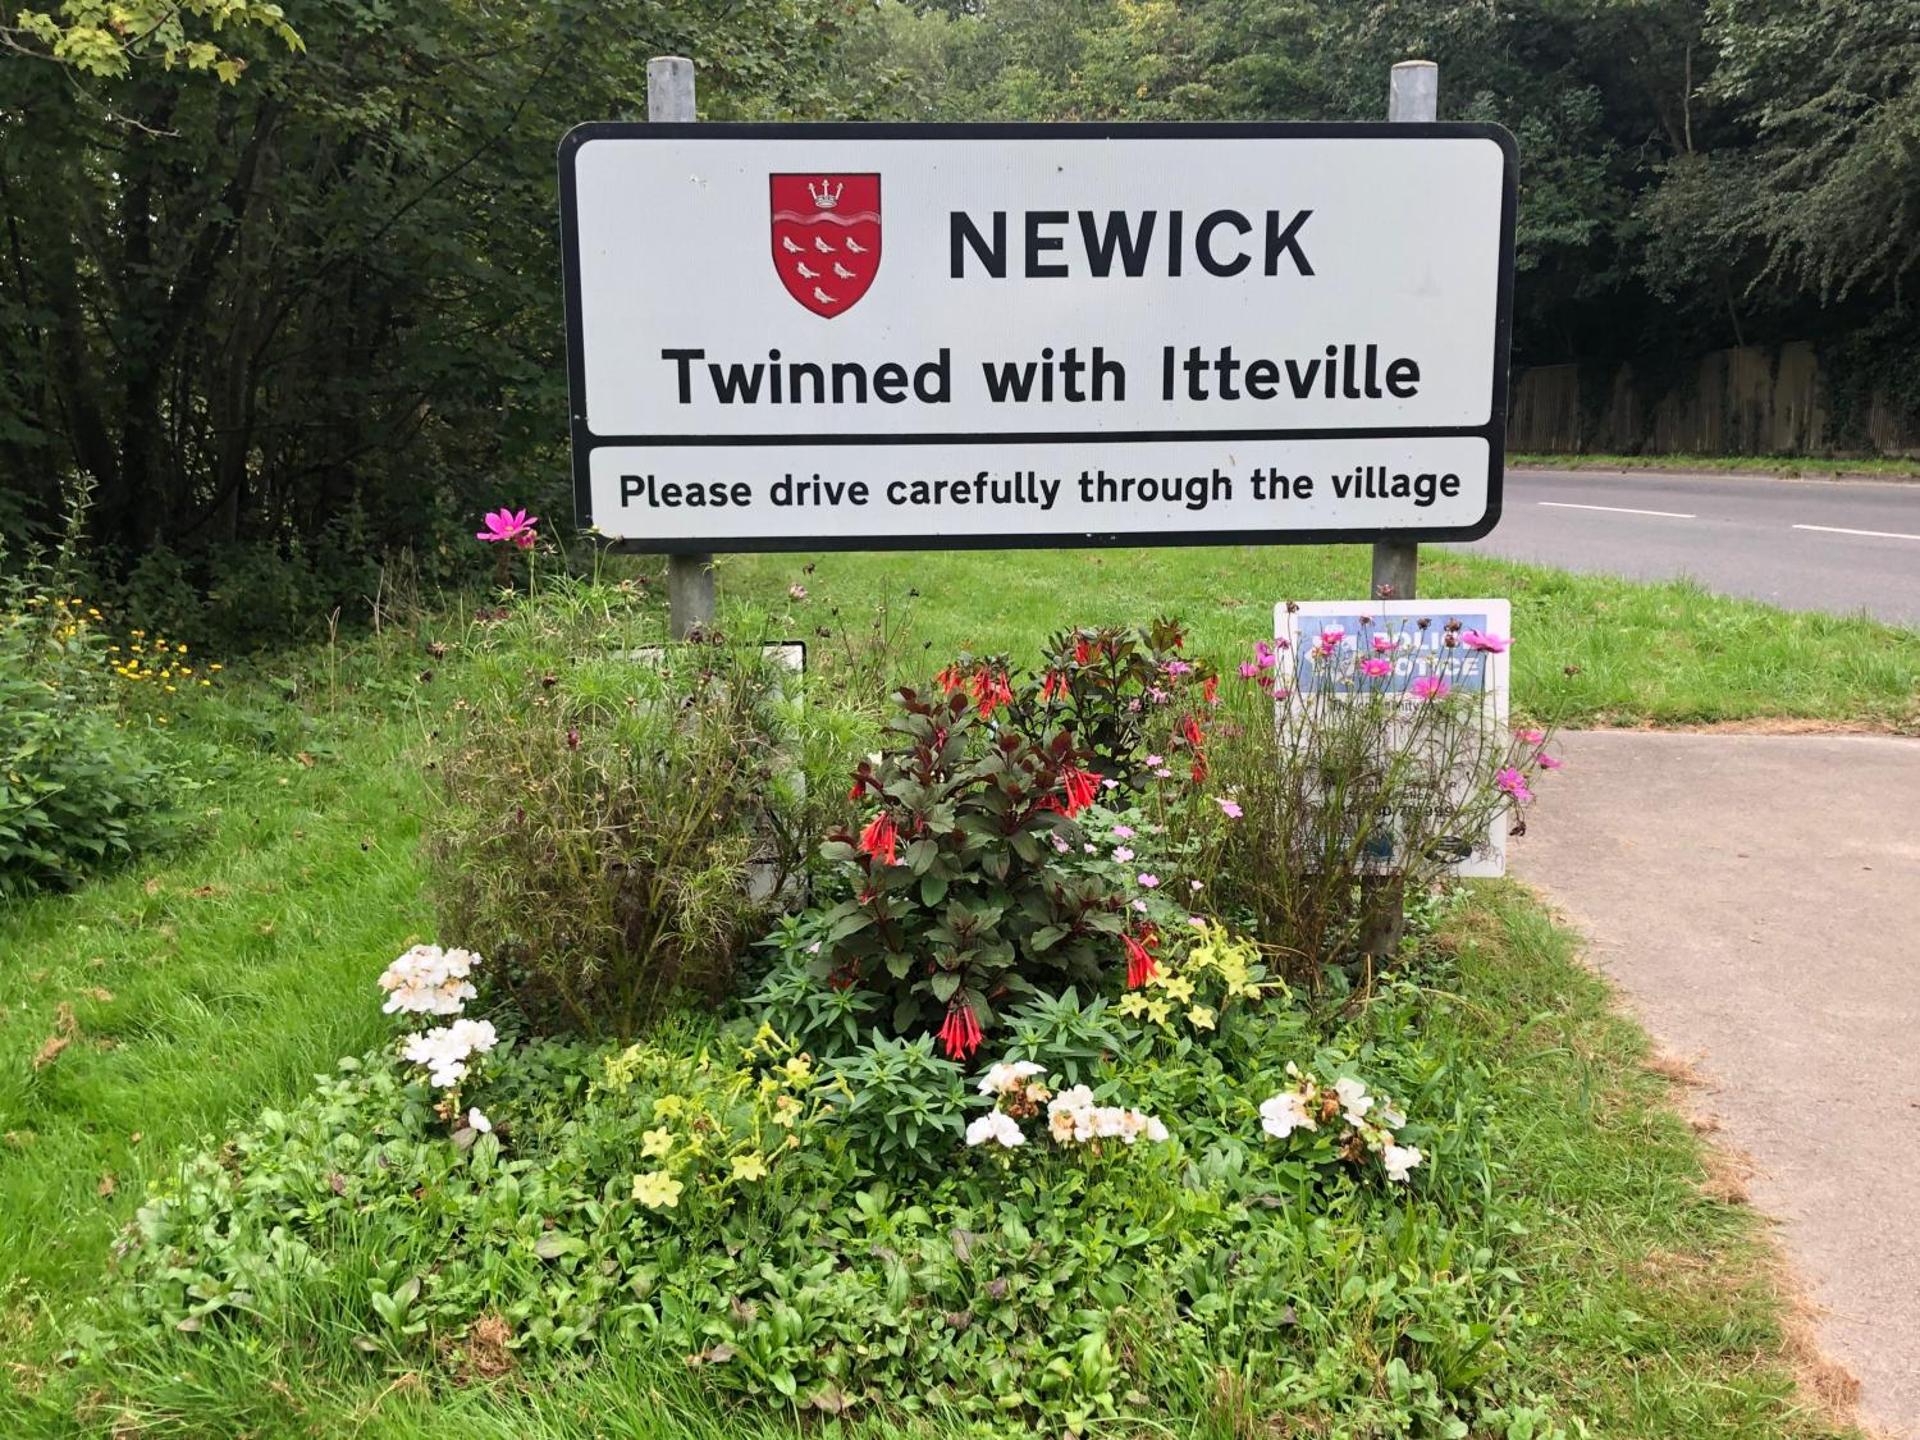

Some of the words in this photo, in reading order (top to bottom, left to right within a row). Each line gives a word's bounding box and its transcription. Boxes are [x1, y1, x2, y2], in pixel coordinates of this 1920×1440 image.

[950, 209, 1316, 279] NEWICK
[661, 347, 951, 404] Twinned
[981, 346, 1126, 403] with
[1162, 343, 1421, 402] Itteville
[620, 474, 752, 508] Please
[769, 473, 870, 507] drive
[886, 471, 1061, 511] carefully
[1077, 468, 1233, 511] through
[1250, 467, 1314, 500] the
[1331, 466, 1461, 508] village
[1373, 631, 1479, 650] OLIC
[1375, 656, 1480, 676] OTICE
